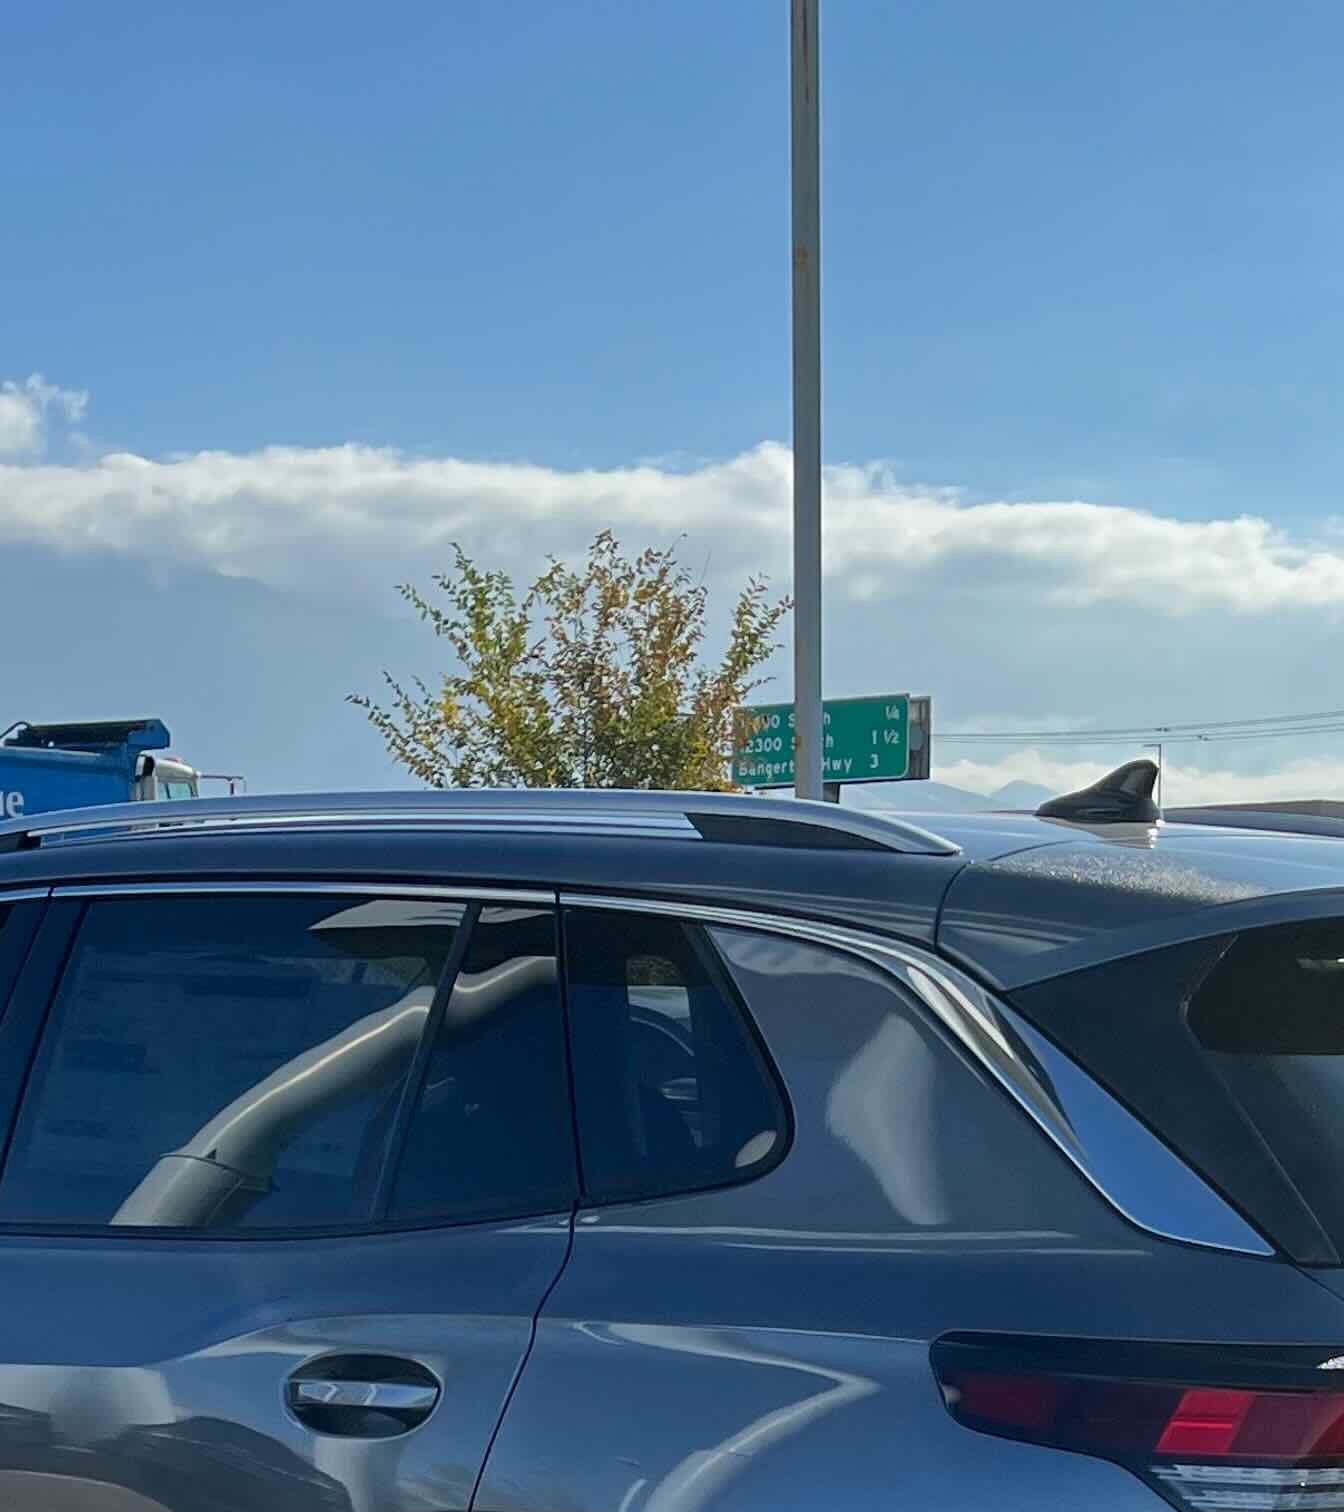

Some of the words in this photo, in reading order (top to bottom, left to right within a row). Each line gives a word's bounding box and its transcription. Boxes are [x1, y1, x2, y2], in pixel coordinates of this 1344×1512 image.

[741, 737, 783, 753] 2300
[738, 758, 795, 782] Bangert
[869, 754, 879, 769] 3
